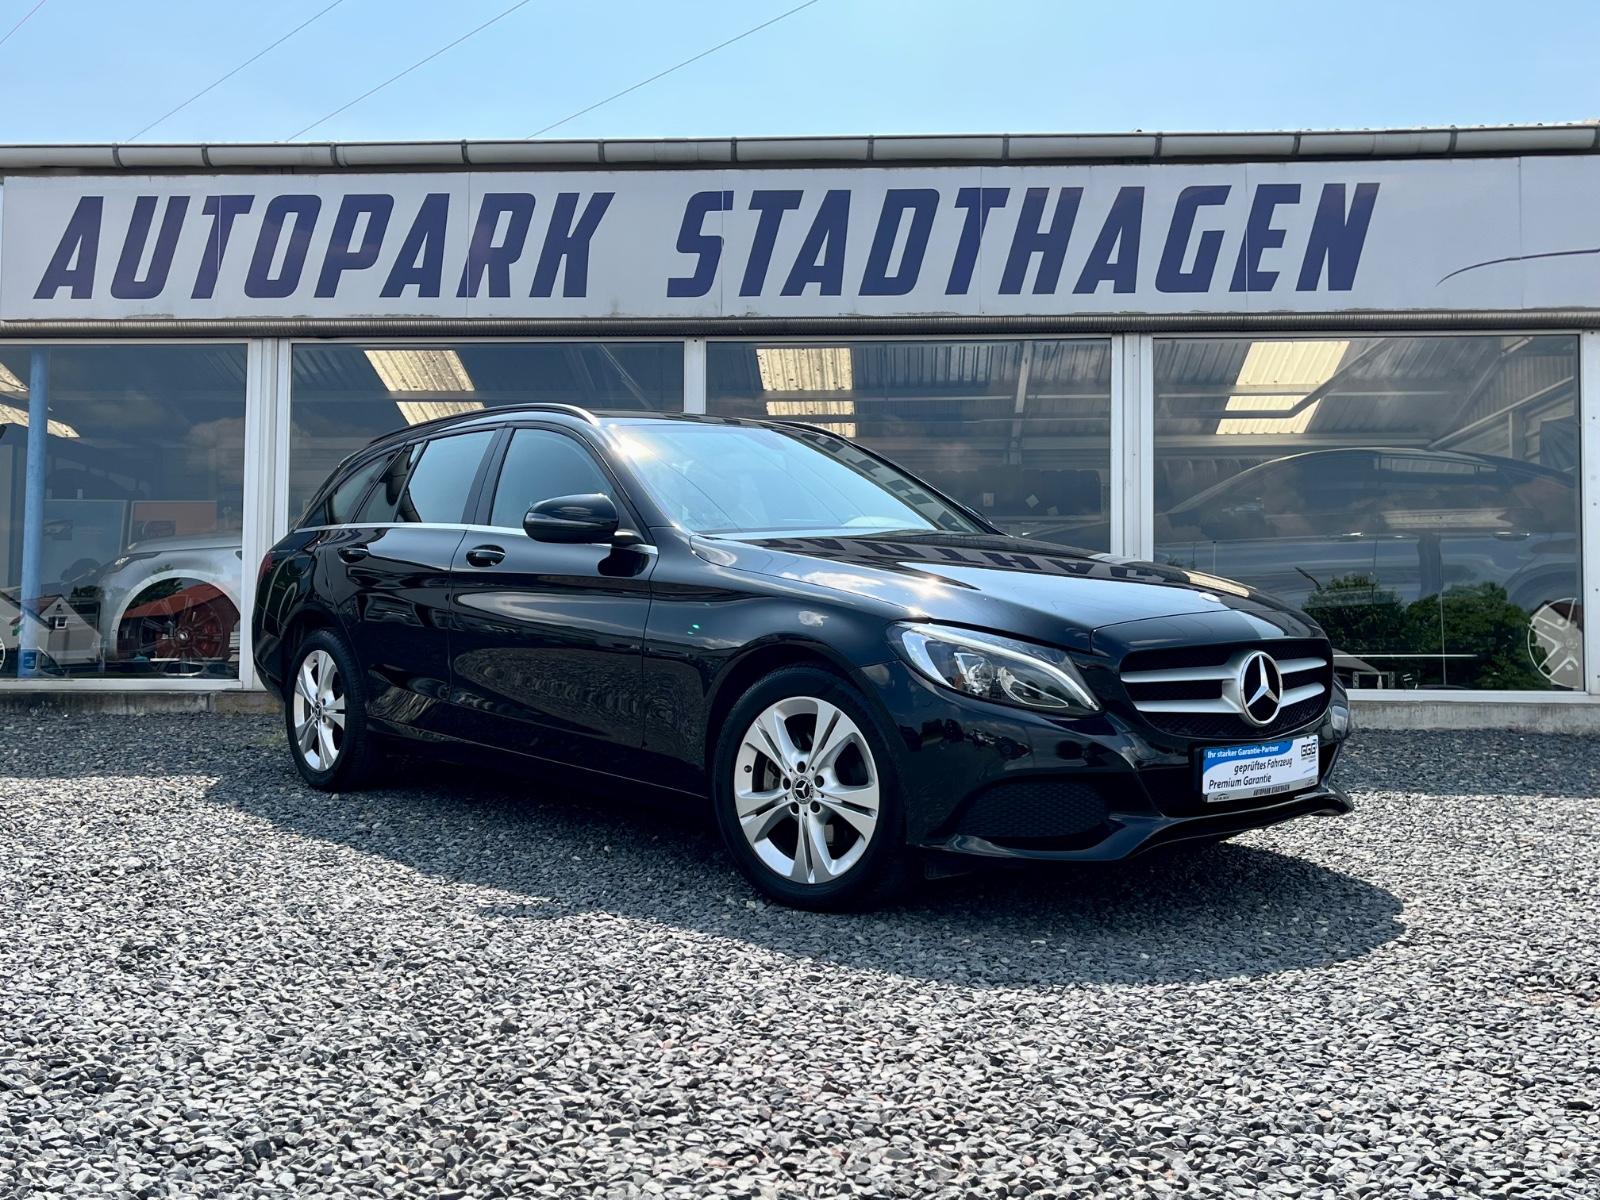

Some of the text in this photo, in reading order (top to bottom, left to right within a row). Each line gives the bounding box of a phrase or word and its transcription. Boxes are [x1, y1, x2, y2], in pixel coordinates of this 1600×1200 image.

[33, 182, 1381, 299] AUTOPARK STADTHAGEN
[1207, 745, 1280, 759] Ihr starker Garantie-Partner
[1234, 757, 1293, 775] geprüftes Fahrzeug
[1209, 773, 1272, 790] Premium Garantie
